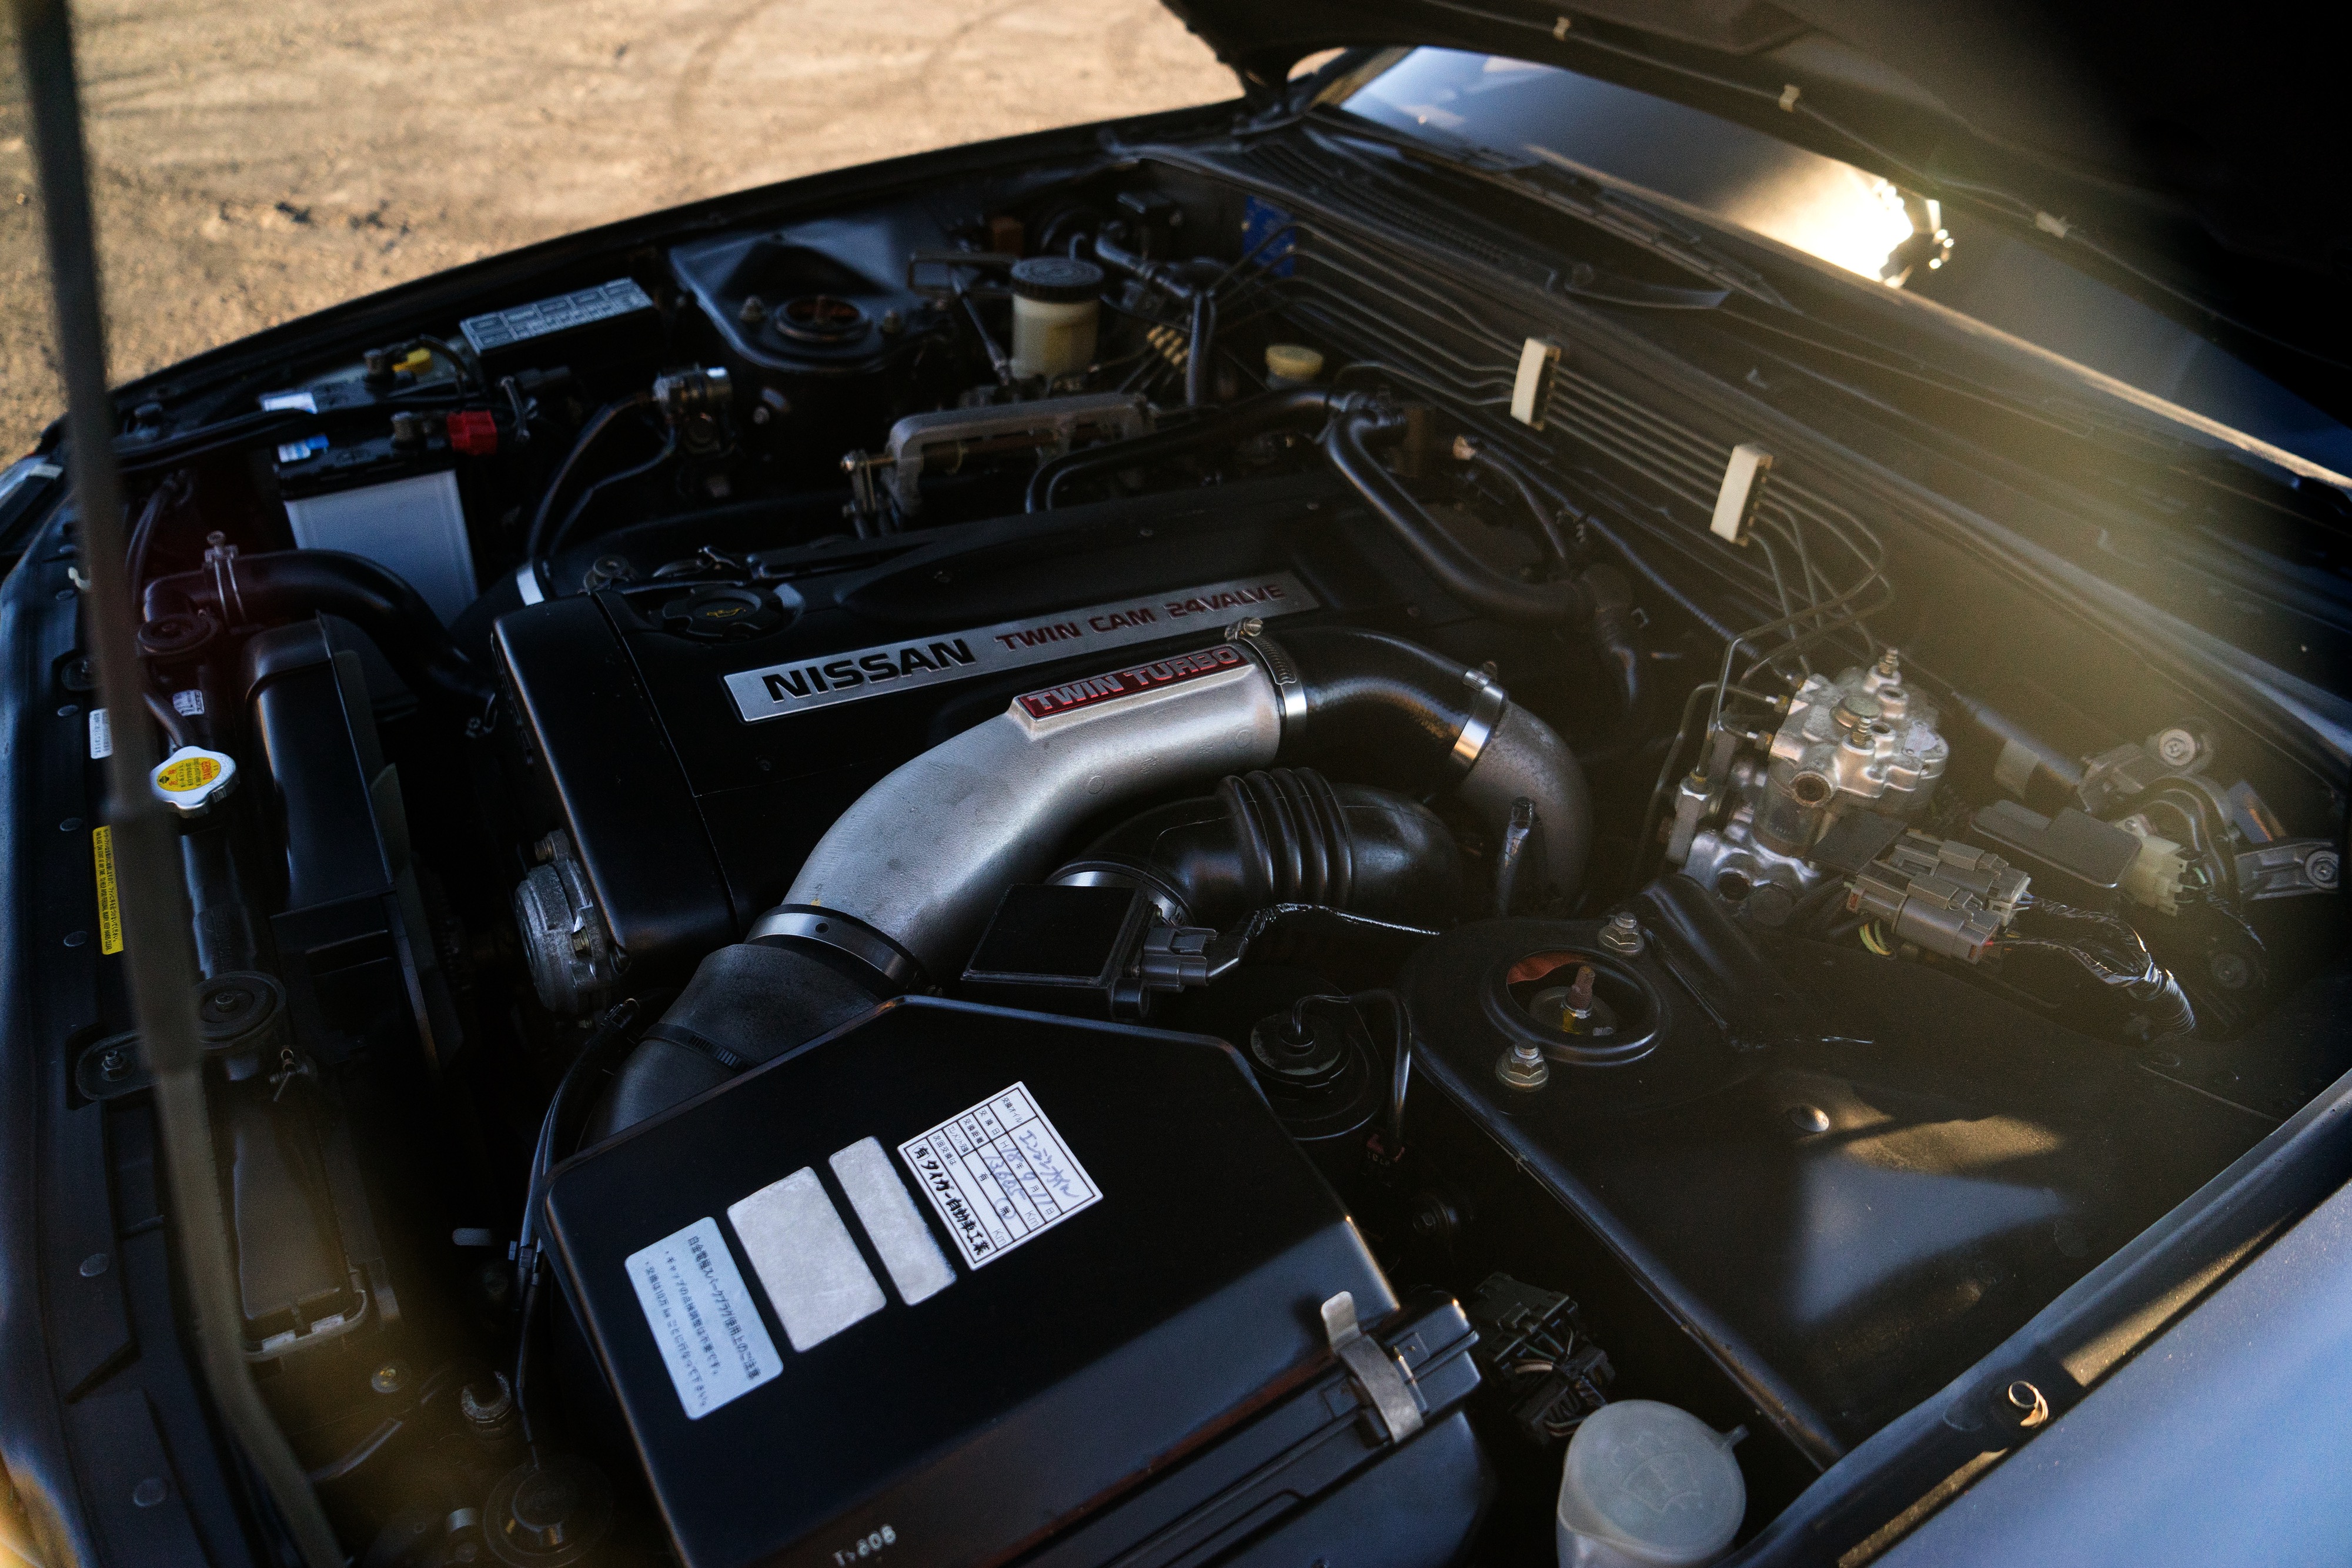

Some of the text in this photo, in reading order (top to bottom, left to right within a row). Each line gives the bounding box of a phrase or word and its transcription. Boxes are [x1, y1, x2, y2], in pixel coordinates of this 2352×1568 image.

[763, 587, 1285, 703] NISSAN TWIN CAM 24VALVE
[1027, 646, 1240, 711] TWIN TURBO
[1001, 1095, 1024, 1124] 交換オイル
[947, 1124, 970, 1154] エレメント交換
[962, 1116, 985, 1145] 交換距離
[932, 1133, 1009, 1246] 次回交換は Km
[977, 1171, 1012, 1216] 有 無
[1024, 1209, 1041, 1228] Km
